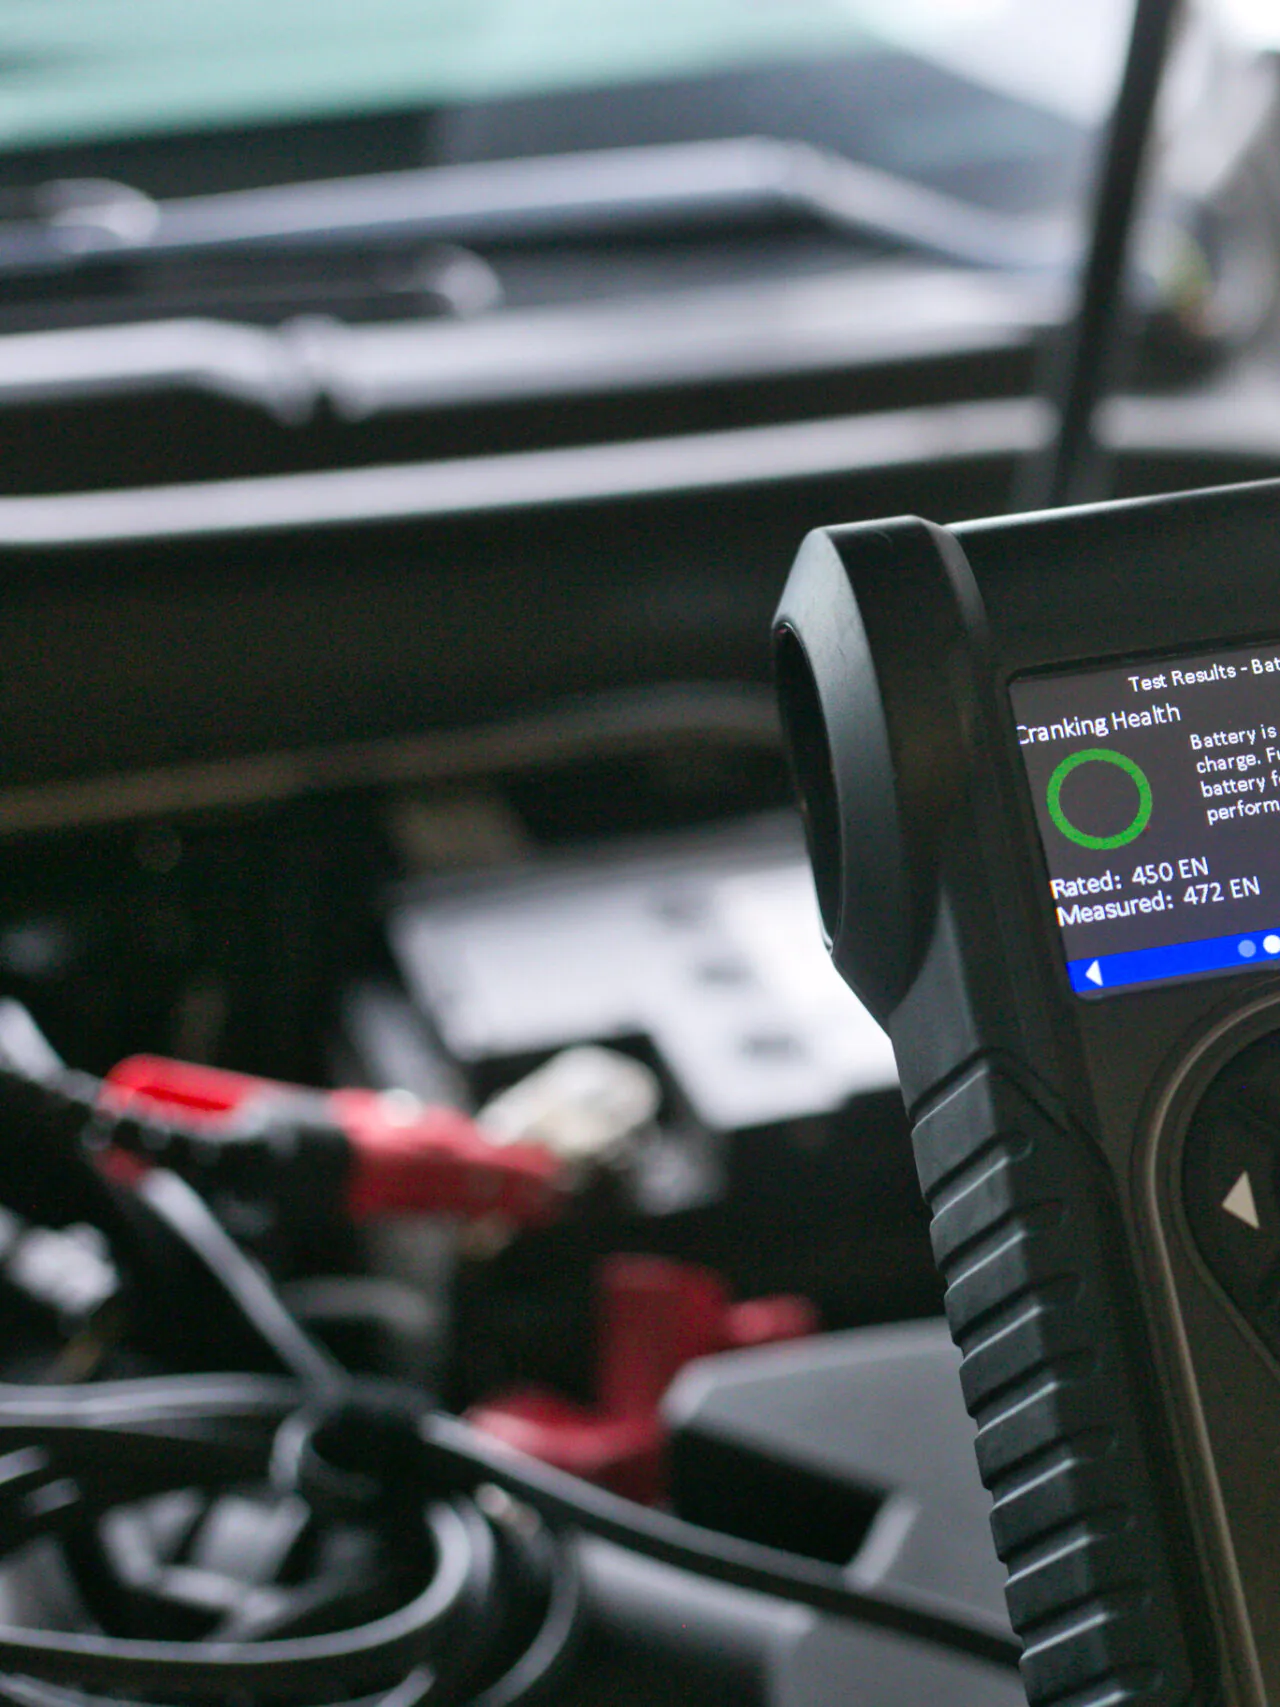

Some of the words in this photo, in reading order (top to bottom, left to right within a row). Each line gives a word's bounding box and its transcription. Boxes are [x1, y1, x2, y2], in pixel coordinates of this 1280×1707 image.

[1127, 674, 1167, 693] Test
[1171, 664, 1237, 687] Results
[1016, 716, 1109, 745] Cranking
[1111, 703, 1181, 731] Health
[1189, 729, 1256, 751] Battery
[1260, 723, 1277, 740] is
[1195, 753, 1261, 774] charge.
[1199, 777, 1266, 798] battery
[1050, 869, 1122, 900] Rated:
[1131, 862, 1174, 886] 450
[1178, 856, 1209, 879] EN
[1057, 889, 1174, 927] Measured:
[1183, 881, 1225, 905] 472
[1229, 875, 1260, 899] EN
